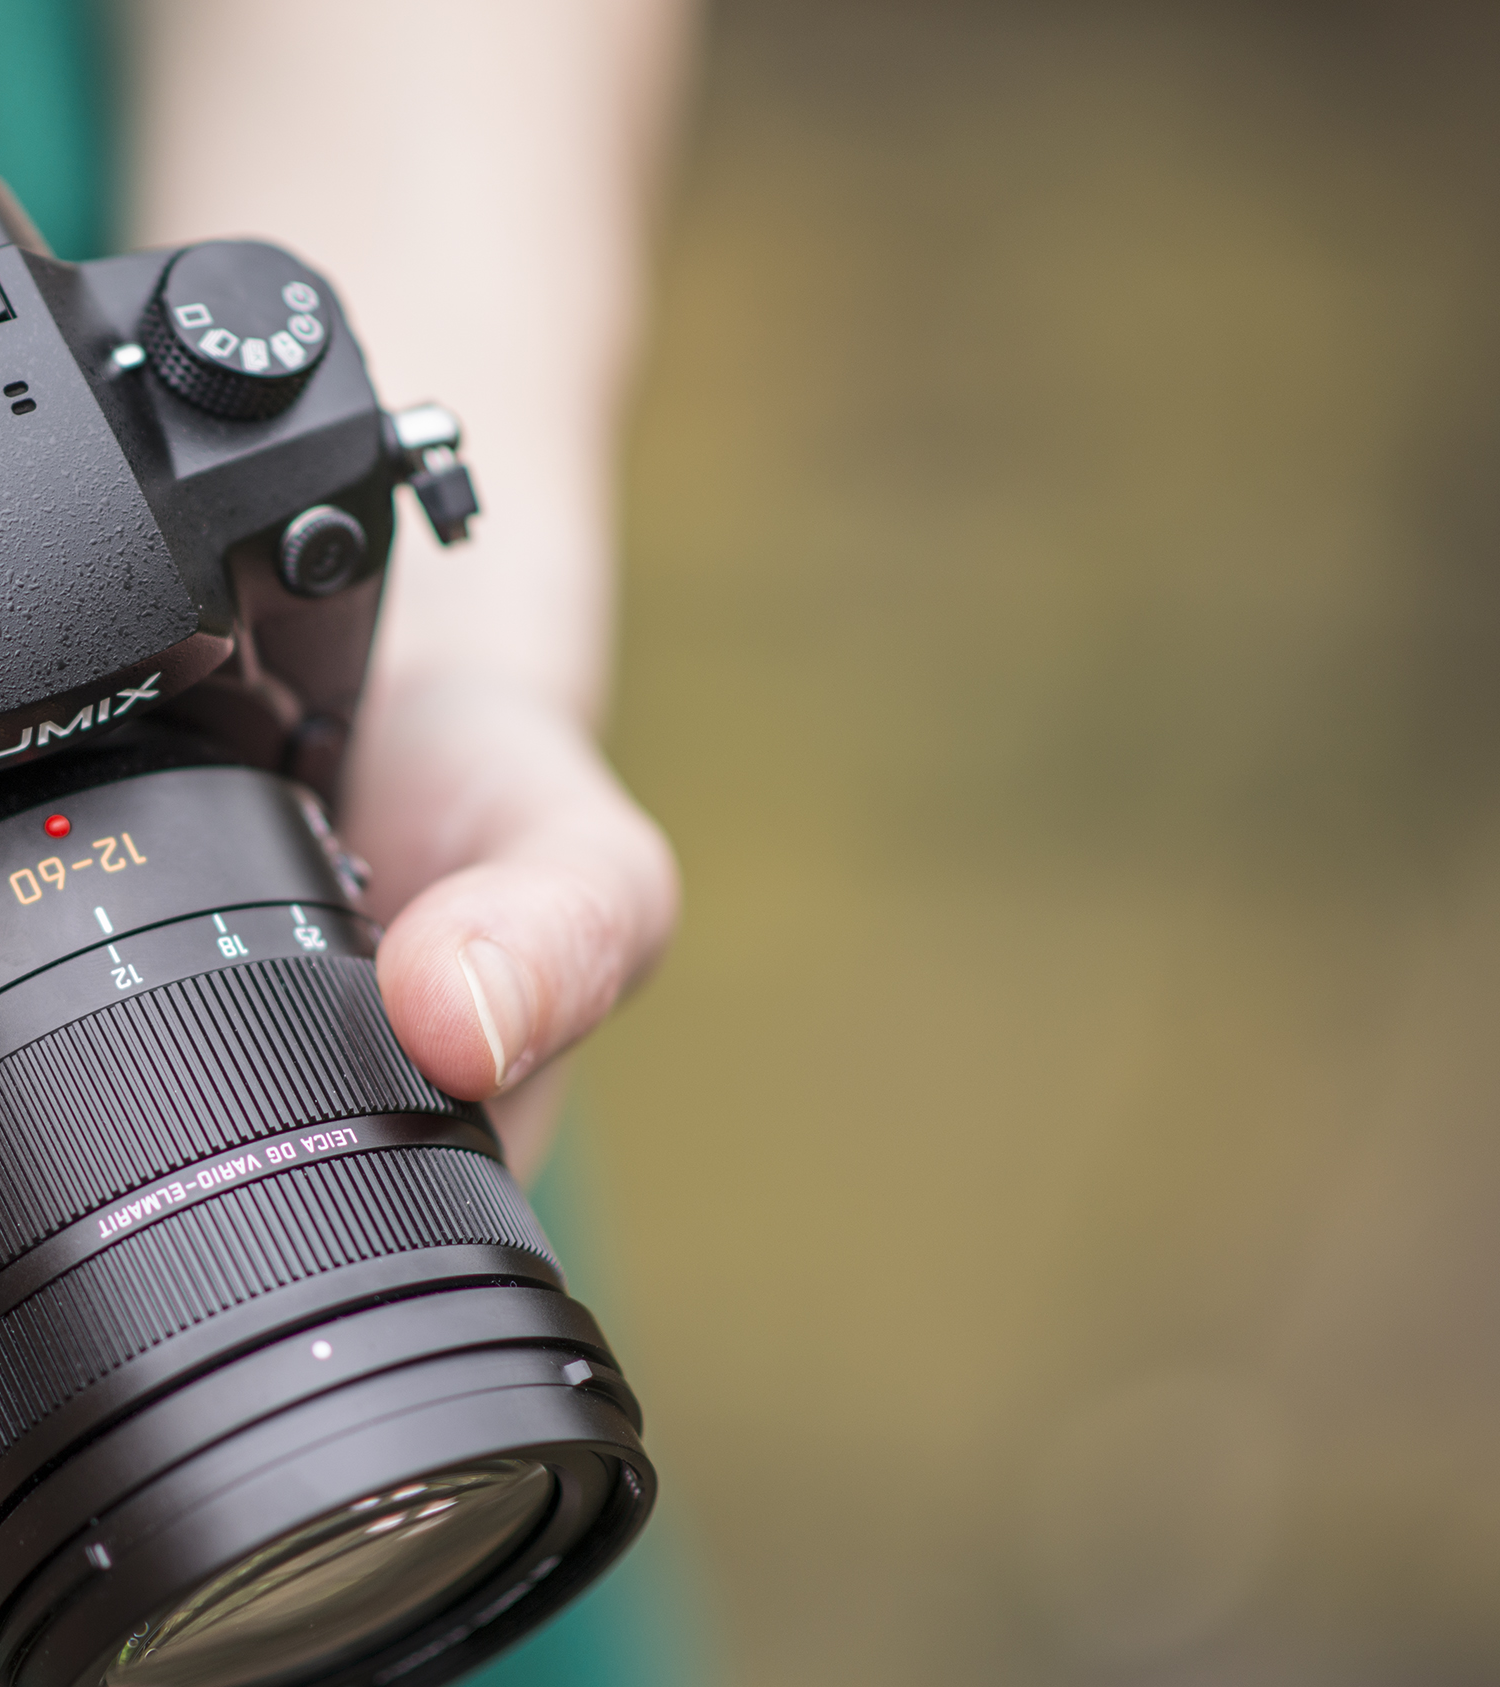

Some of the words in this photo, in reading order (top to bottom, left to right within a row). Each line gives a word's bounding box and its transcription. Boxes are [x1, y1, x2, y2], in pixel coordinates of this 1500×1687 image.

[9, 832, 148, 906] 12-60
[216, 933, 249, 959] 18
[293, 925, 328, 952] 25
[110, 963, 144, 991] 12
[265, 1141, 297, 1165] DG
[300, 1126, 359, 1154] LEICA
[98, 1153, 263, 1240] VARIO-ELMARIT
